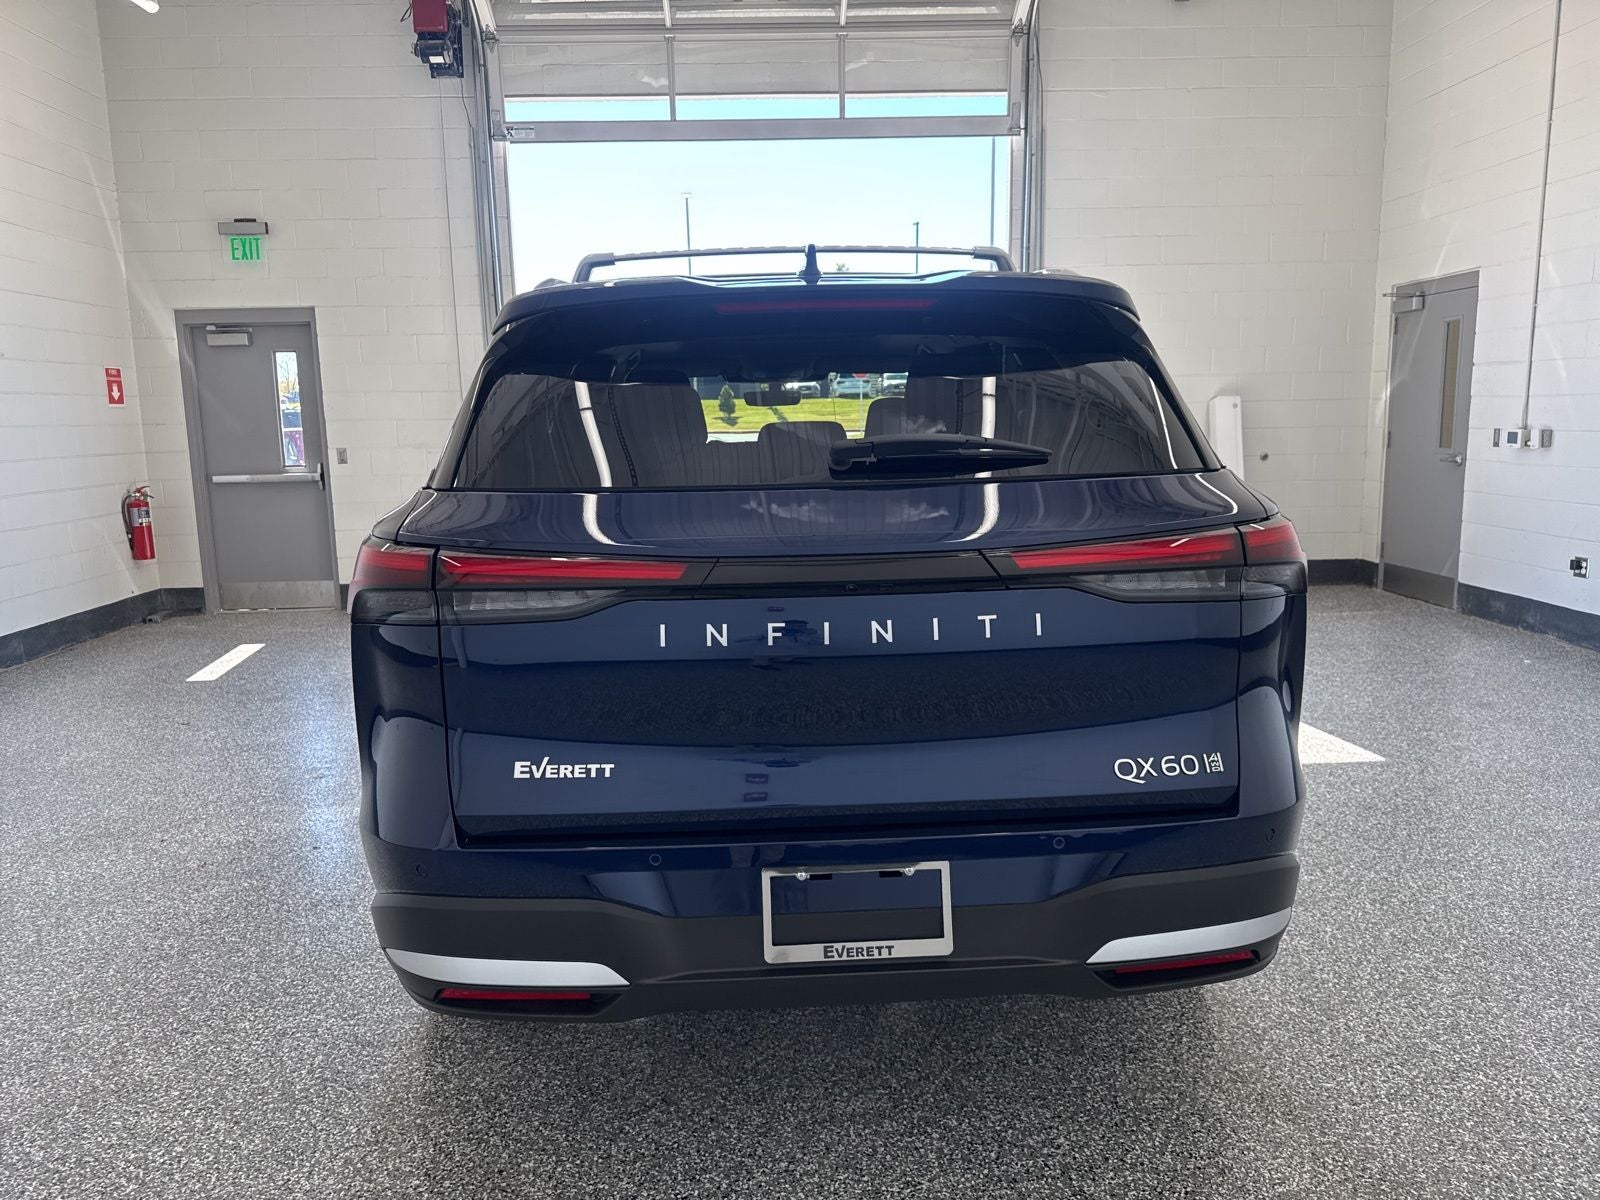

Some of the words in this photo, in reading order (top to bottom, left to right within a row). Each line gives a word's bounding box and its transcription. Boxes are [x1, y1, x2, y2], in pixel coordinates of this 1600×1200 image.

[230, 237, 260, 260] EXIT
[659, 612, 1042, 647] INFINITI
[513, 756, 615, 778] EVERETT
[1114, 754, 1199, 784] QX60
[823, 945, 894, 959] EVERETT
